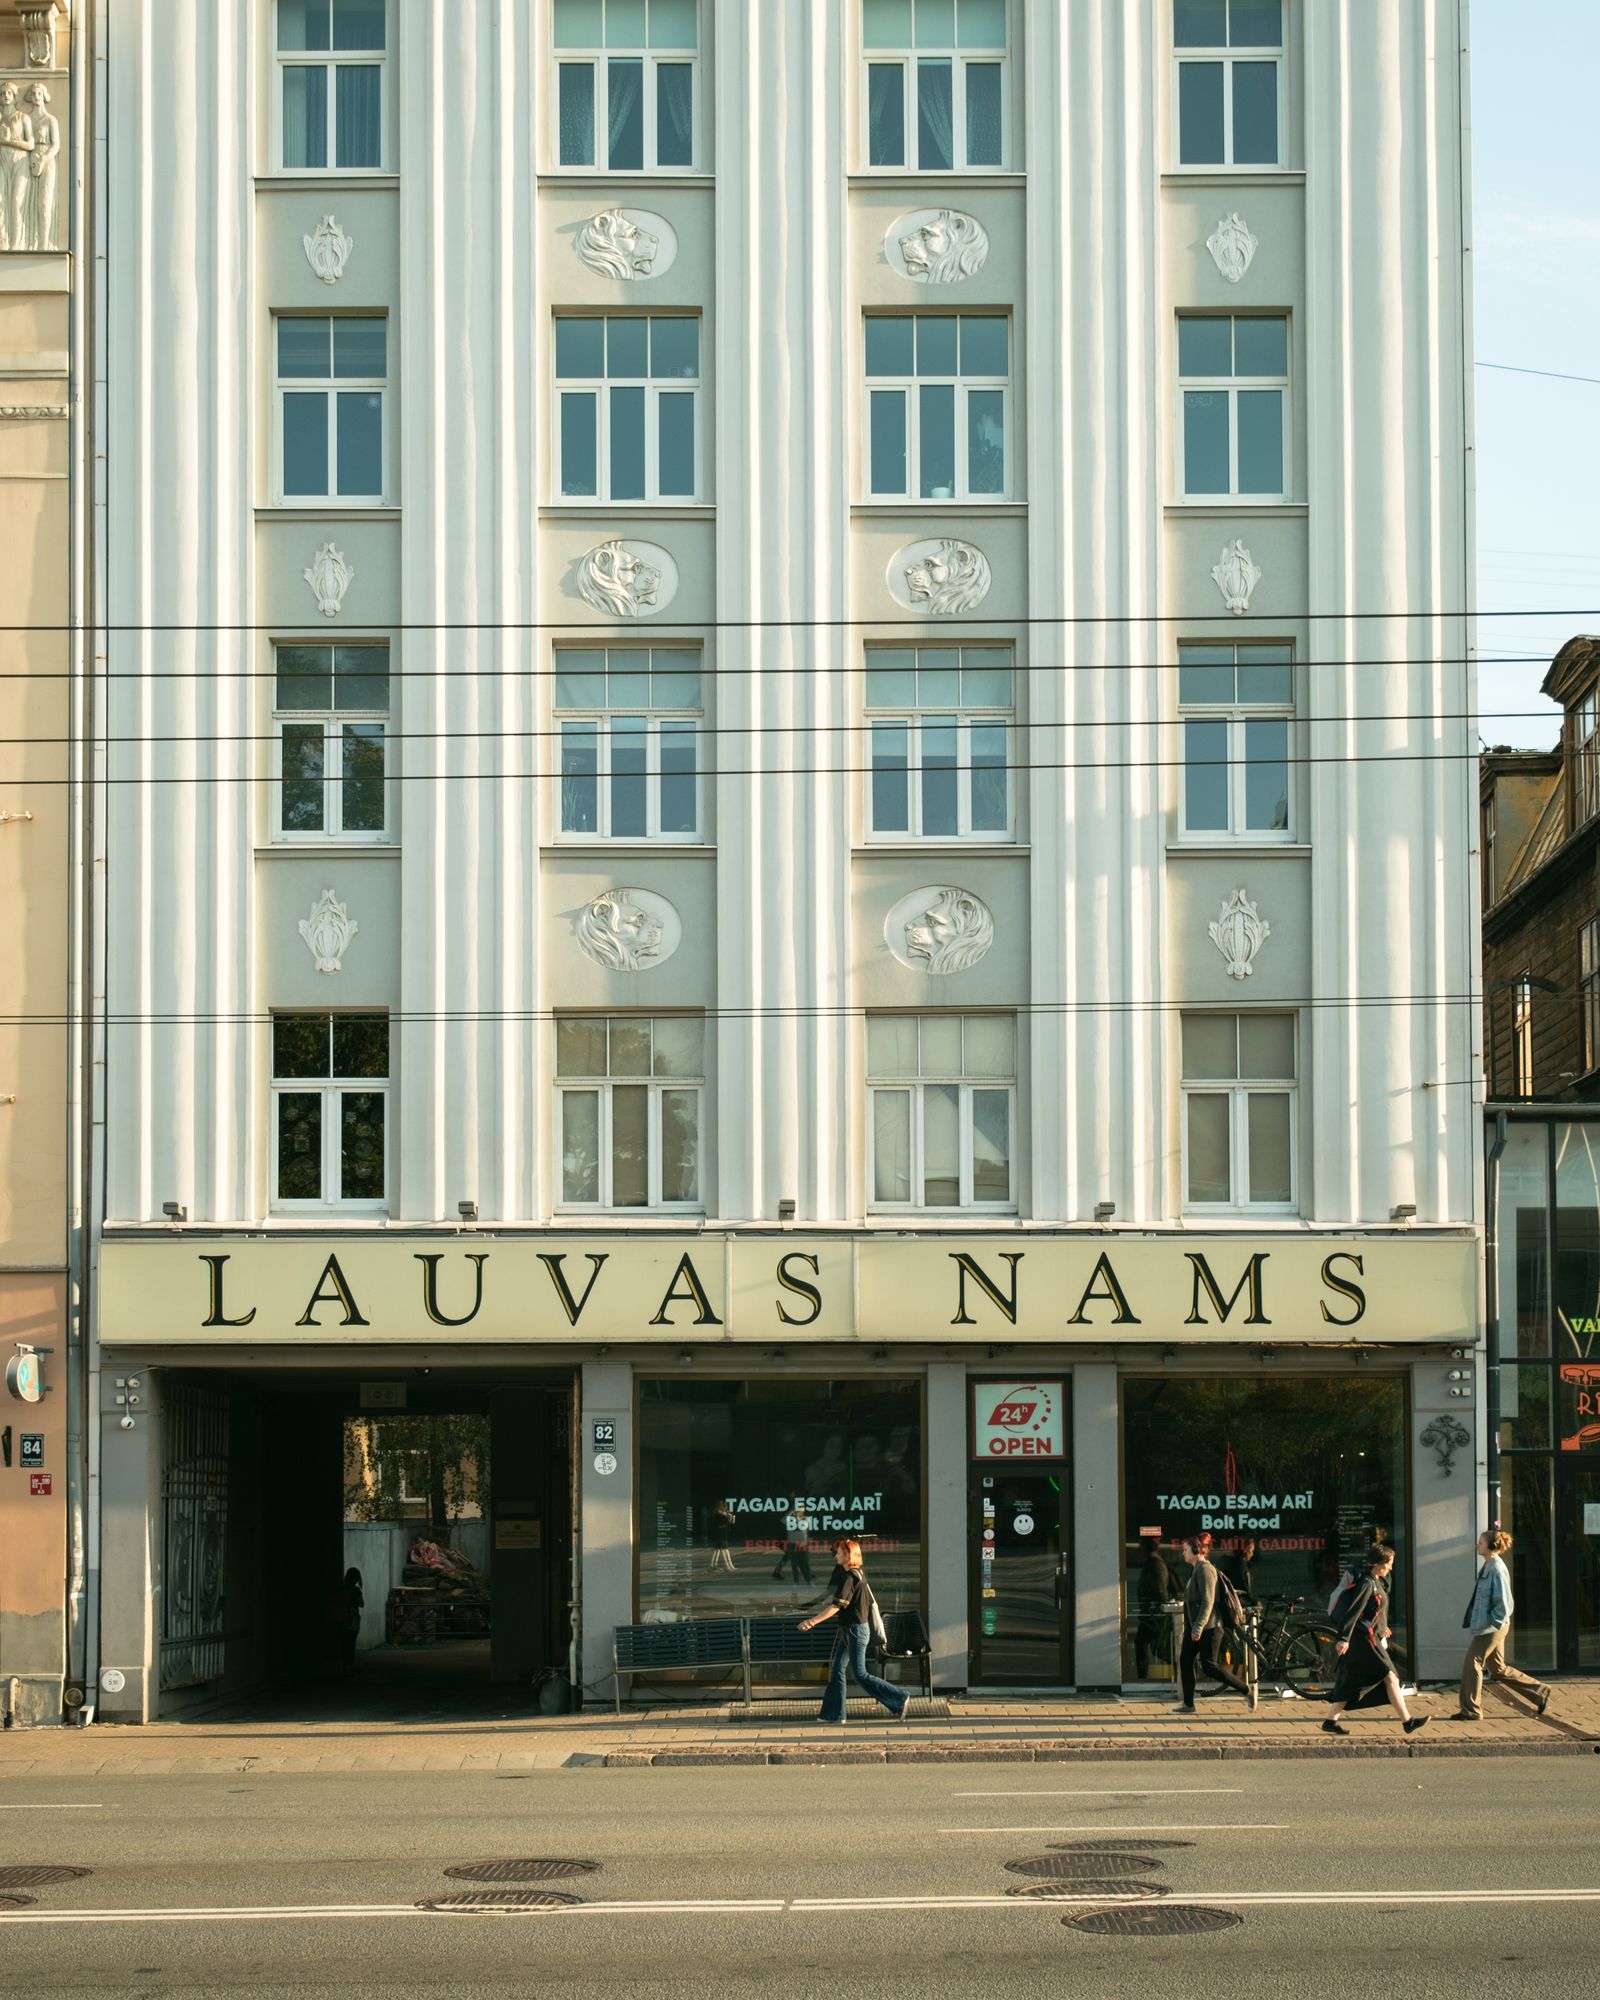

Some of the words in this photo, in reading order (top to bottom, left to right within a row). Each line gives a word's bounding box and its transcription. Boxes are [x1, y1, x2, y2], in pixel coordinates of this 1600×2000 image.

[198, 1252, 822, 1327] LAUVAS
[948, 1251, 1366, 1326] NAMS
[596, 1426, 613, 1439] 82
[23, 1441, 41, 1454] 84
[989, 1437, 1051, 1455] OPEN
[725, 1497, 789, 1512] TAGAD
[794, 1496, 845, 1511] ESAM
[850, 1492, 882, 1511] ARĪ
[1157, 1495, 1221, 1510] TAGAD
[1225, 1494, 1277, 1509] ESAM
[1281, 1490, 1314, 1509] ARĪ
[786, 1515, 819, 1531] Bolt
[822, 1514, 865, 1531] Food
[1202, 1514, 1235, 1530] Bolt
[1238, 1513, 1280, 1530] Food
